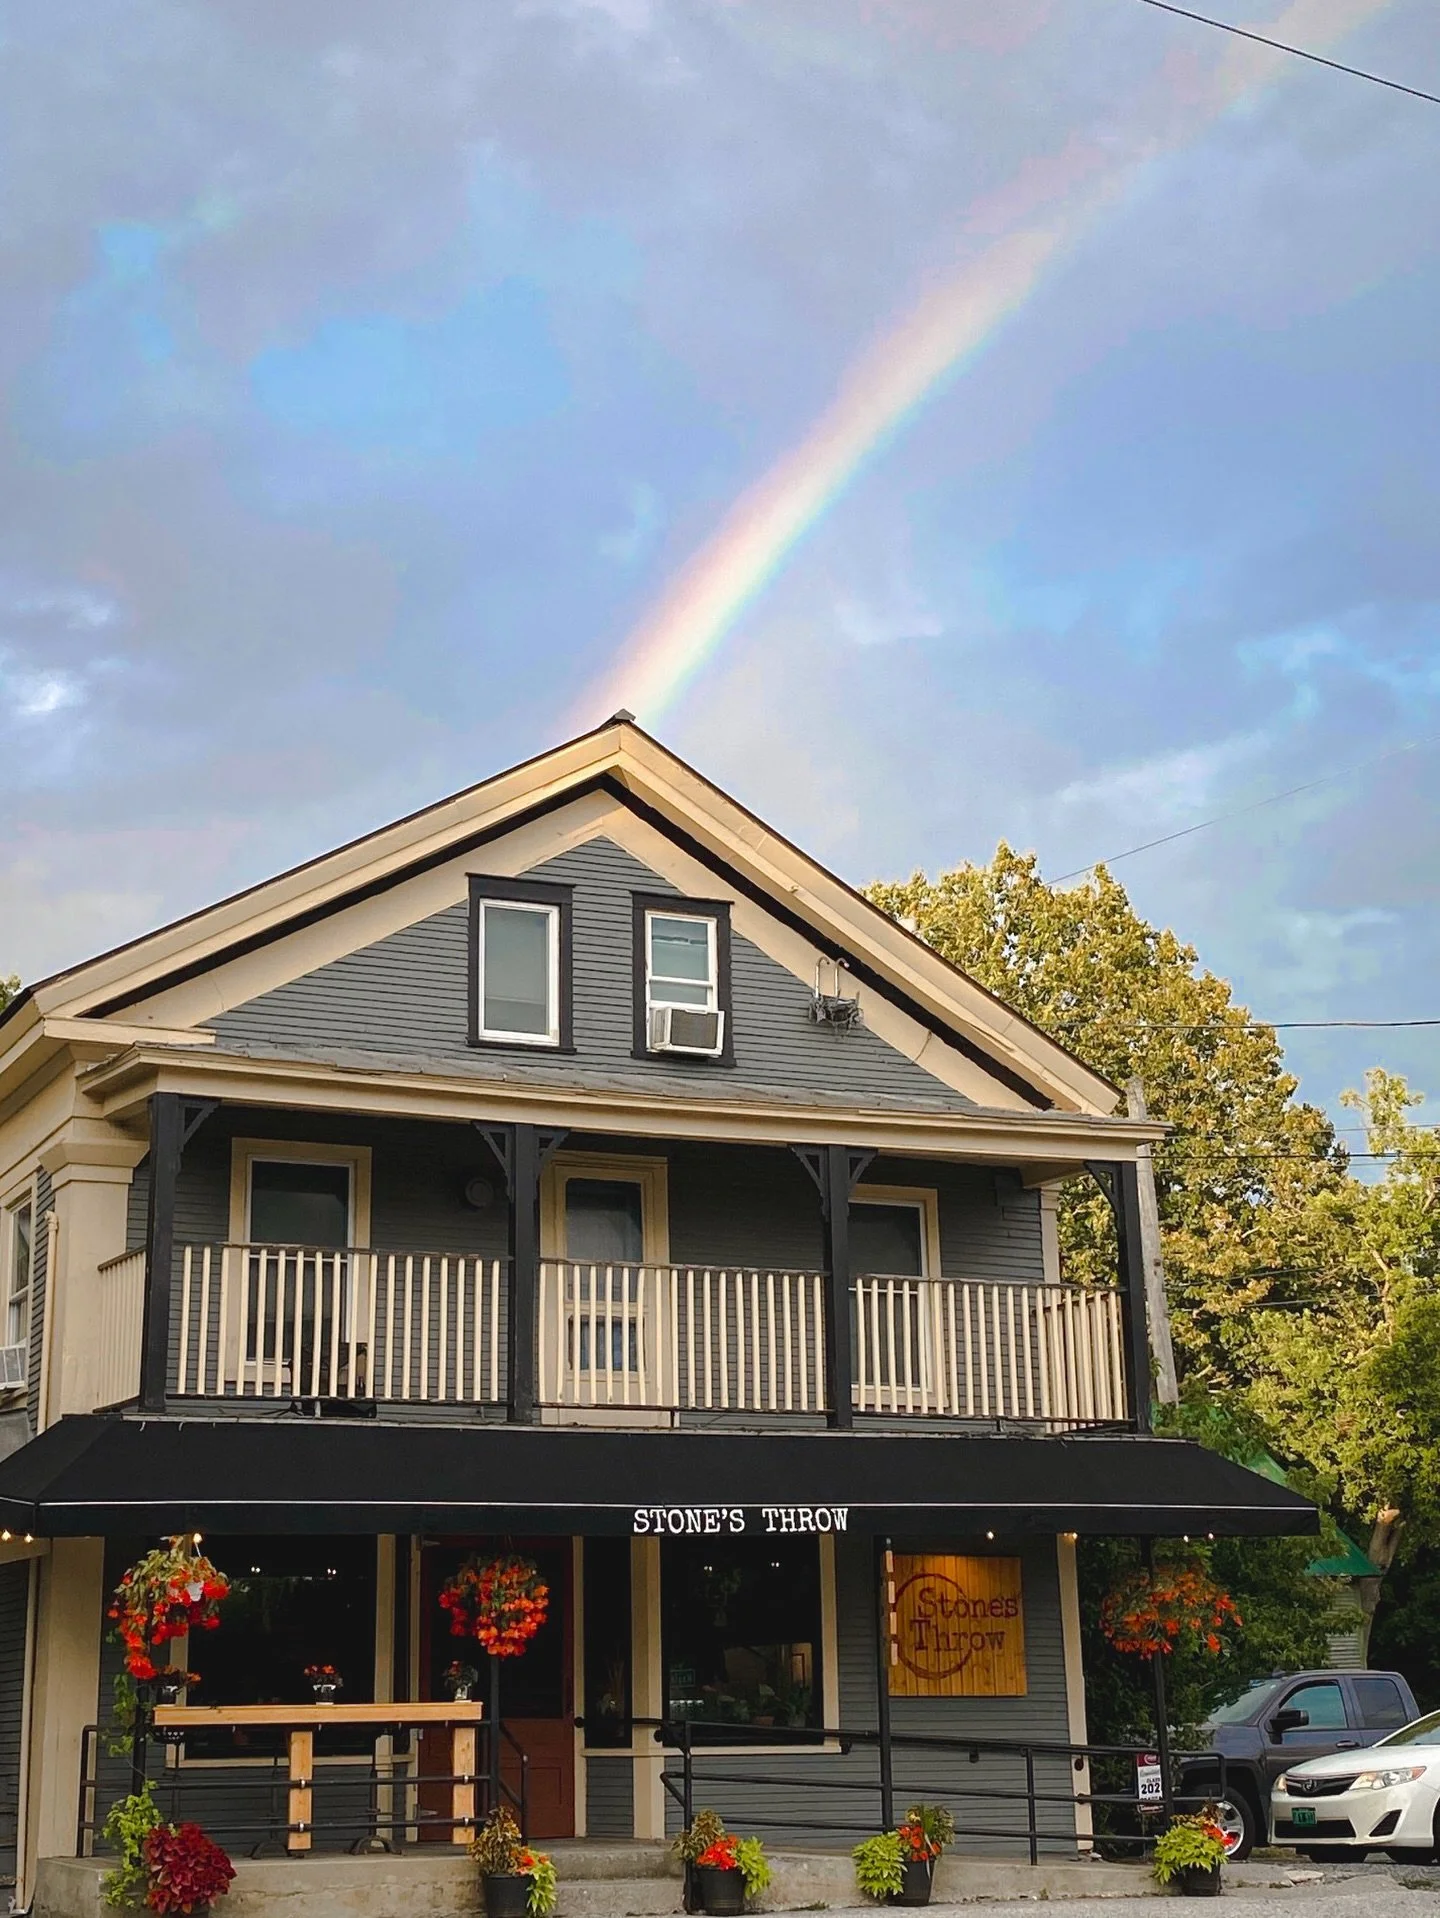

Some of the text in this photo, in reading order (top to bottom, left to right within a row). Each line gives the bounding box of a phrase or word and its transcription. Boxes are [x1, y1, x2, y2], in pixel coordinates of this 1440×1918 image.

[633, 1507, 849, 1534] STONE'S THROW
[909, 1618, 1006, 1652] Throw
[1141, 1783, 1160, 1794] 202
